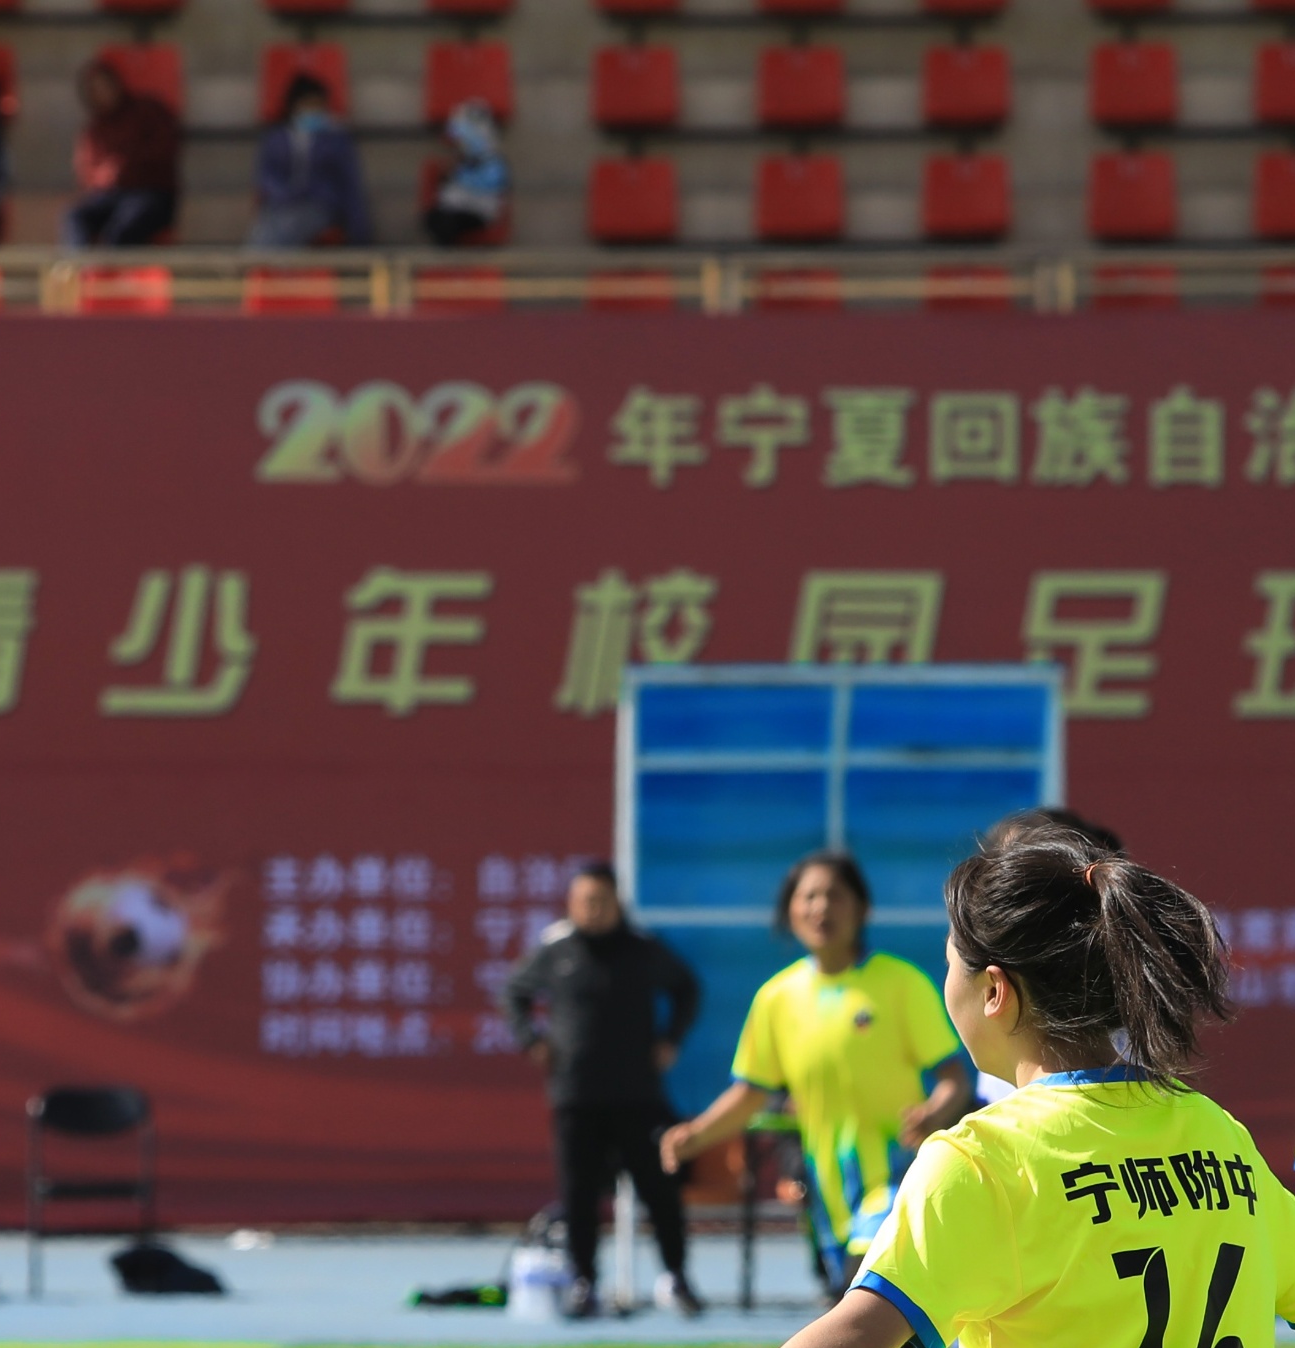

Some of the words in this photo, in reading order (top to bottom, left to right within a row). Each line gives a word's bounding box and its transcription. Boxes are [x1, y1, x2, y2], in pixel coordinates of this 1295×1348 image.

[256, 379, 581, 484] 2022
[1061, 1150, 1258, 1225] 宁师附中
